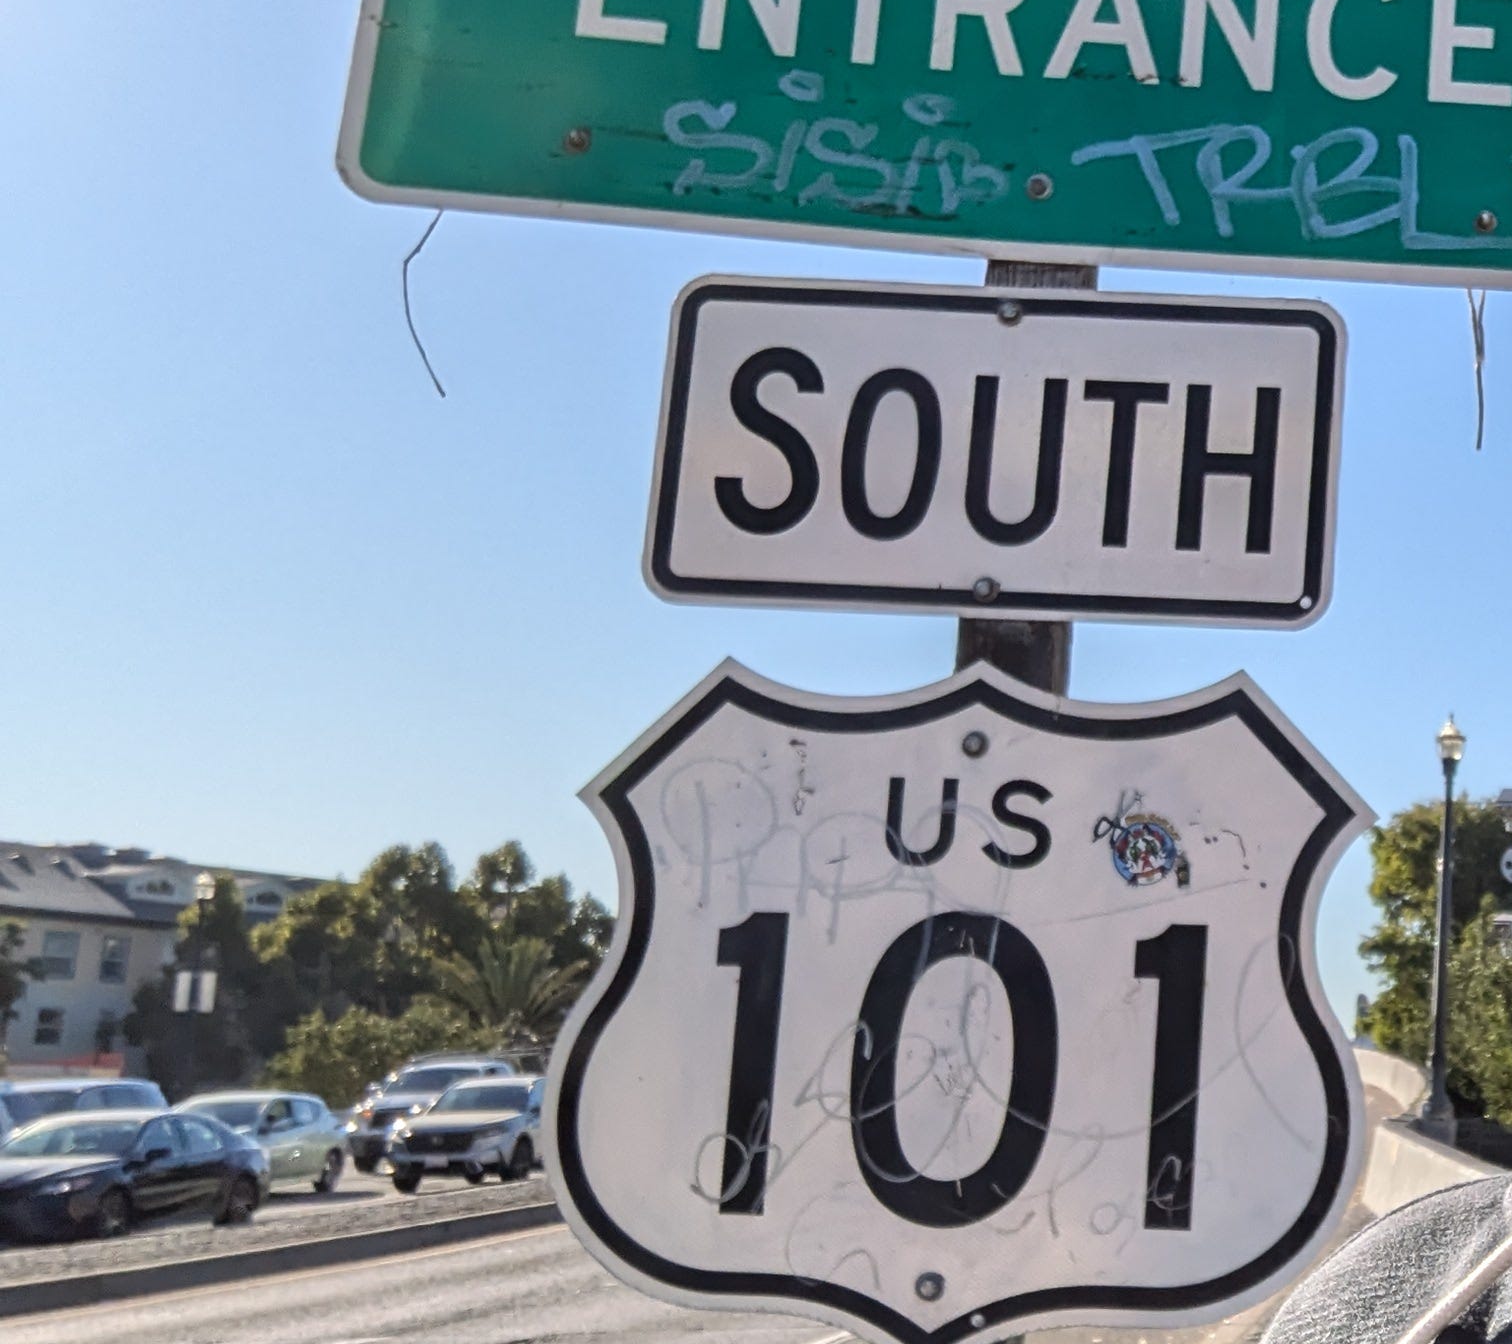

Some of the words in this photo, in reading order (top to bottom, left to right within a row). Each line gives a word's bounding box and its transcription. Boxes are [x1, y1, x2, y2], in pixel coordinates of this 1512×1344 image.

[713, 346, 1282, 554] SOUTH
[885, 776, 1053, 869] US
[716, 910, 1209, 1230] 101
